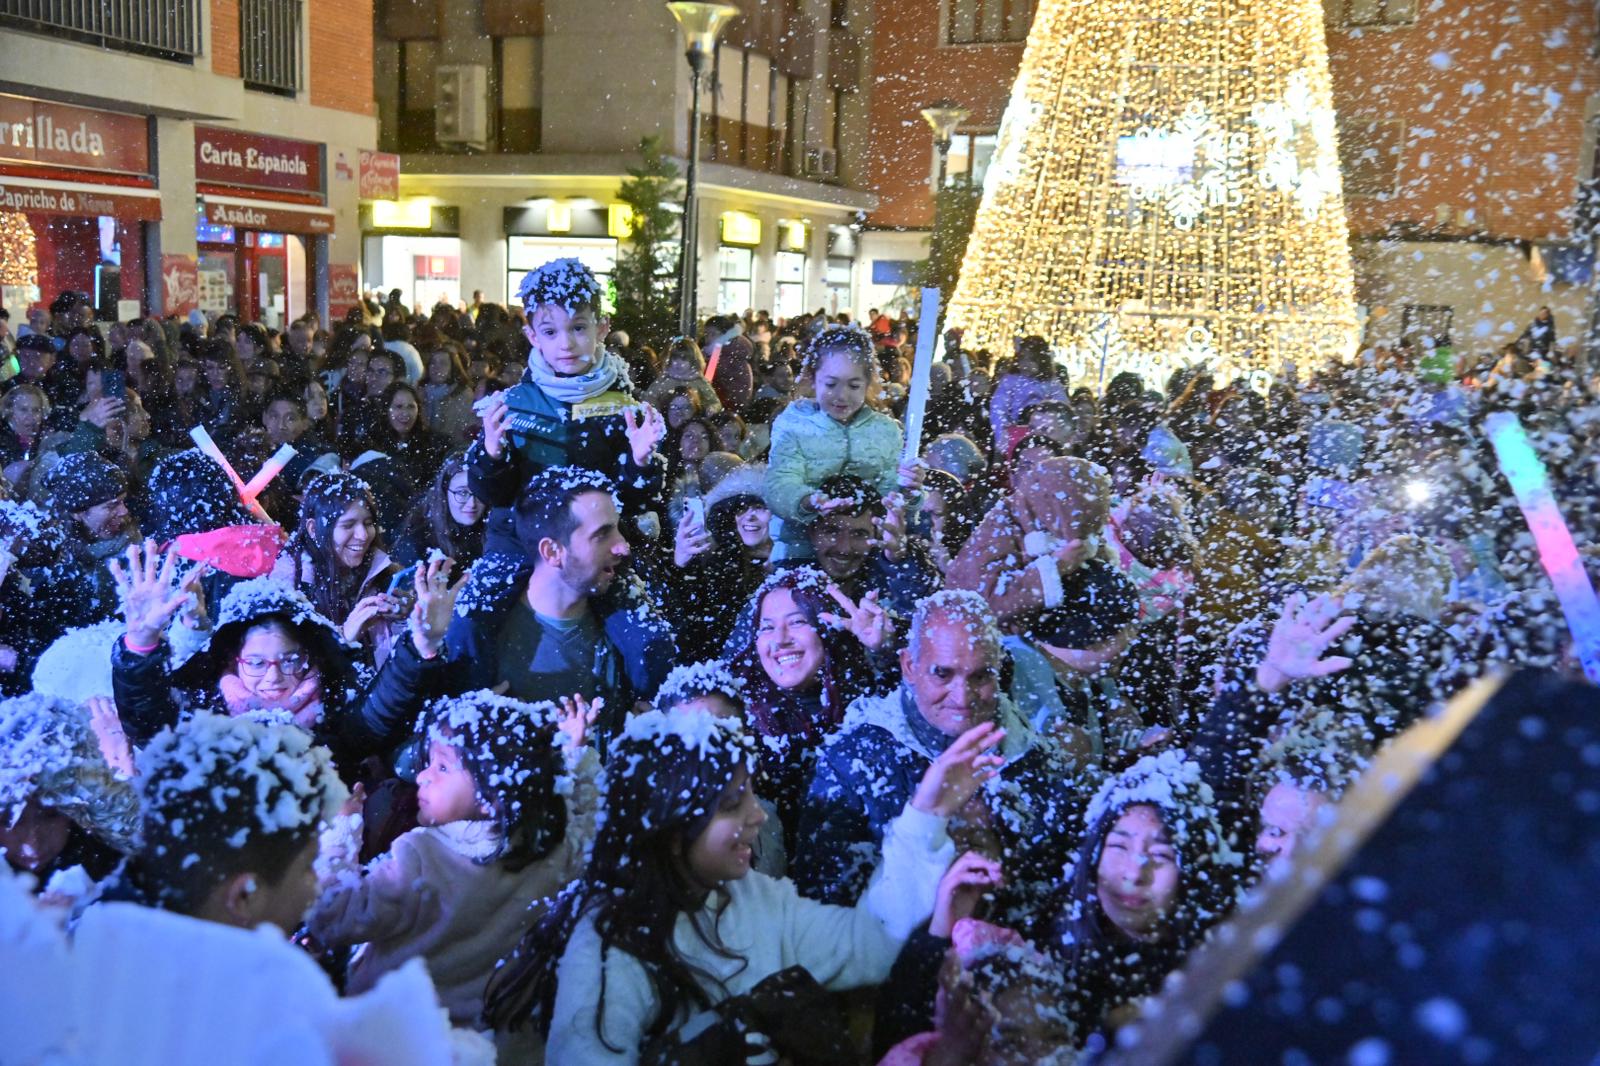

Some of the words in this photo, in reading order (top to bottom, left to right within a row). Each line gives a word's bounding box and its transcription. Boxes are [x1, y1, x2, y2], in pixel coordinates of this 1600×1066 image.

[200, 142, 242, 168] Carta
[245, 147, 308, 175] Española
[60, 192, 76, 211] de
[213, 205, 267, 225] Asador
